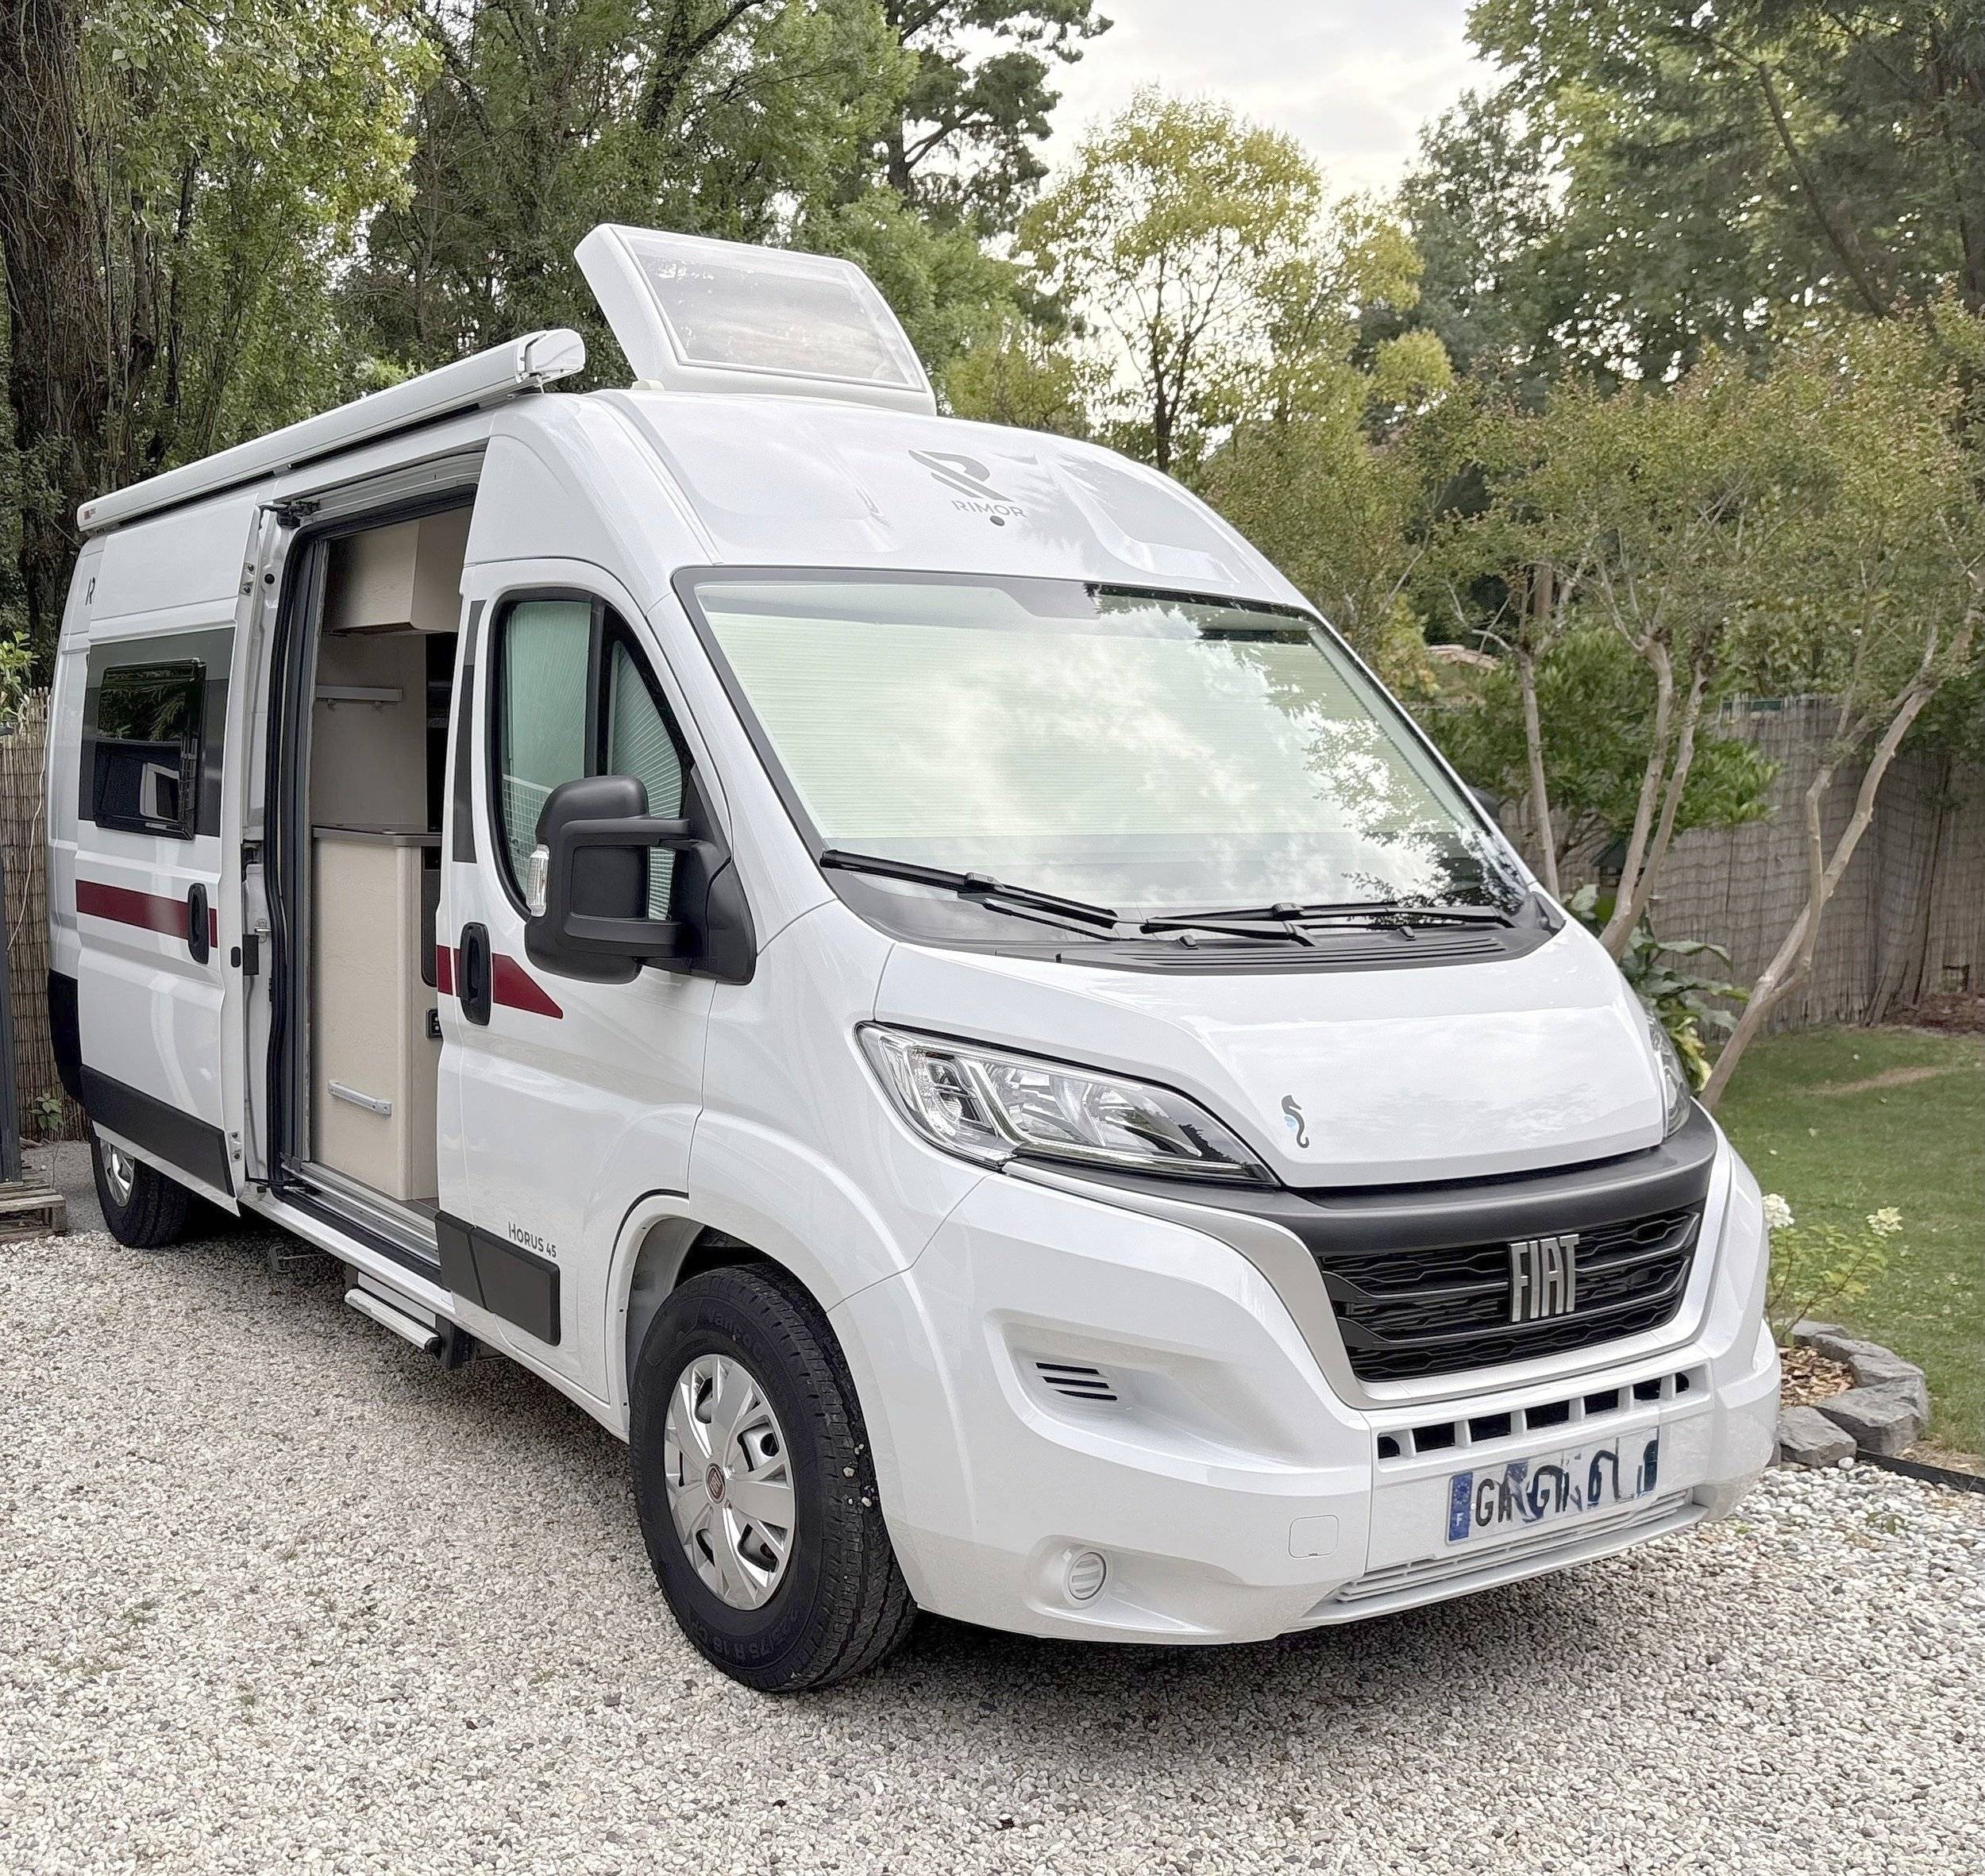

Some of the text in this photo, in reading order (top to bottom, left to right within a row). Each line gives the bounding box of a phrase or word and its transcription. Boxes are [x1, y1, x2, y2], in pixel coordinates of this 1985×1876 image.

[951, 500, 1027, 518] RIMOR
[508, 1222, 557, 1258] HORUS 45
[1510, 1234, 1579, 1323] FIAT
[1456, 1512, 1464, 1526] F
